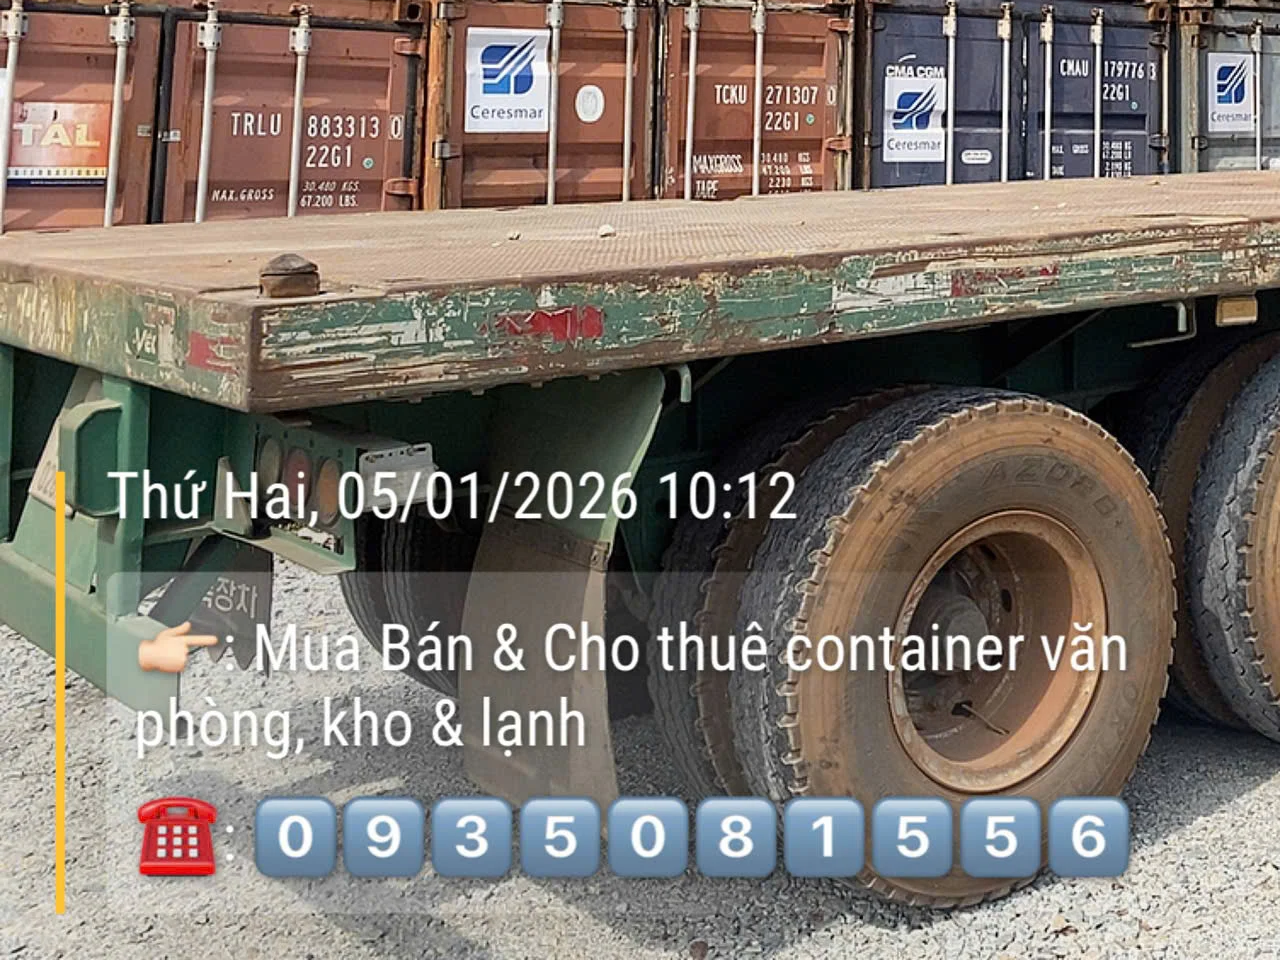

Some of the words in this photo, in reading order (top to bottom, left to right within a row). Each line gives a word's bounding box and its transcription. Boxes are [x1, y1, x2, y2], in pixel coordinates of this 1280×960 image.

[885, 65, 915, 78] CMA
[916, 65, 945, 79] CGM
[1060, 59, 1089, 78] CMAU
[1103, 61, 1145, 80] 179776
[714, 84, 748, 106] TCKU
[764, 85, 819, 106] 271307
[1103, 83, 1131, 102] 22G1
[470, 104, 544, 121] Ceresmar
[764, 111, 800, 132] 22G1
[1210, 110, 1252, 123] Ceresmar
[13, 121, 100, 149] TAL
[230, 111, 282, 137] TRLU
[306, 114, 381, 140] 883313
[391, 116, 402, 140] 0
[886, 138, 942, 152] Ceresmar
[305, 144, 354, 169] 22G1
[338, 195, 359, 208] LBS.
[202, 576, 258, 619] 장차
